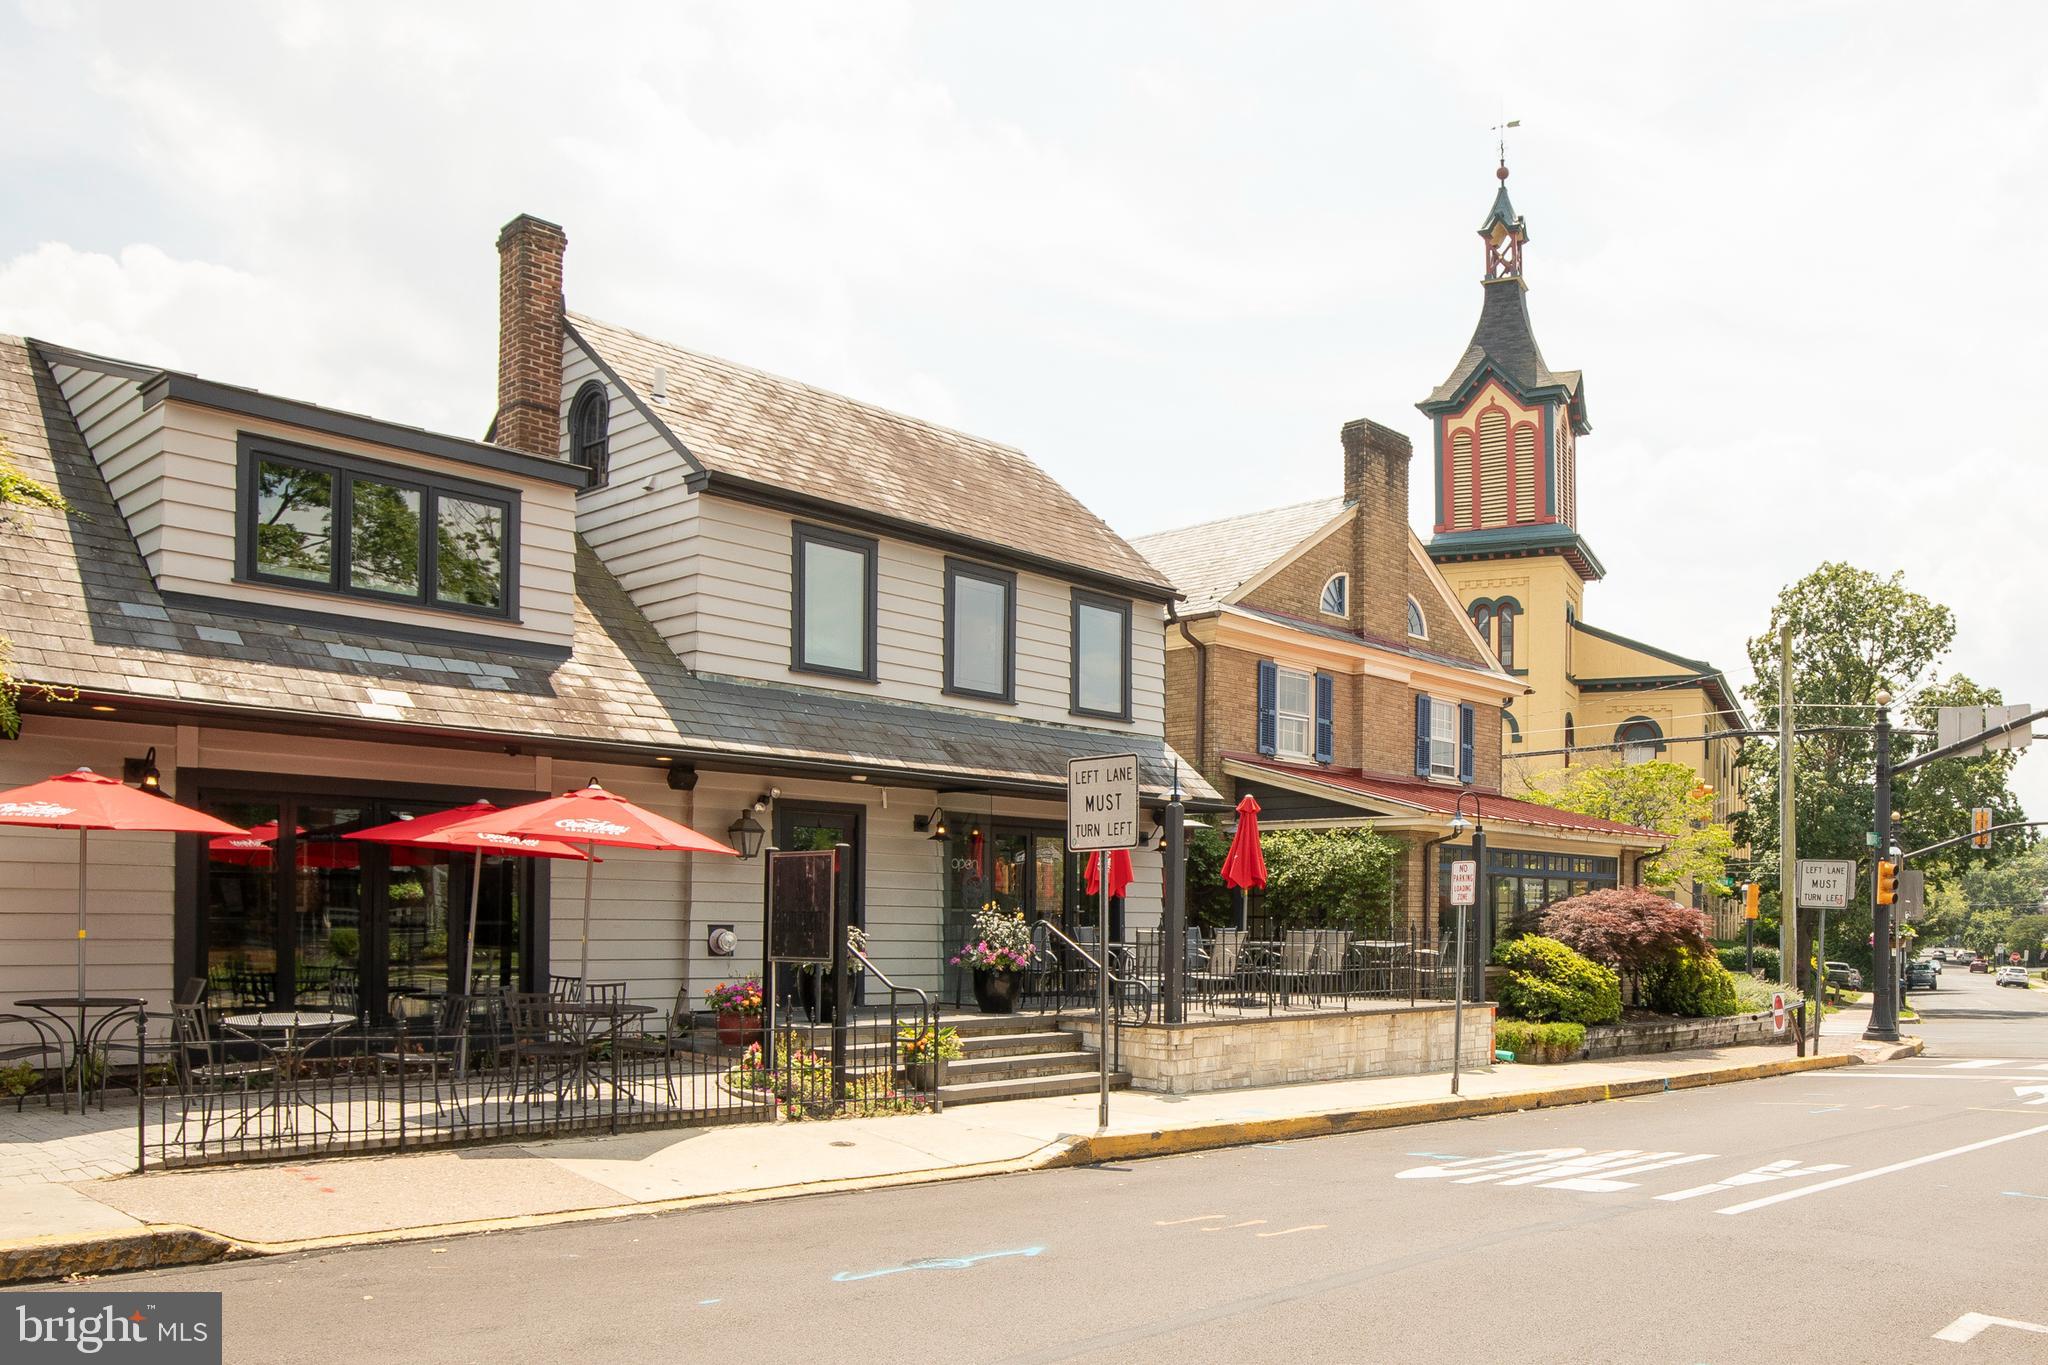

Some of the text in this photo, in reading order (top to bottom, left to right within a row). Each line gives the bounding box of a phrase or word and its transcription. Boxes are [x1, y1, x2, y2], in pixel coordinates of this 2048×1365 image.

[1075, 766, 1133, 785] LEFT LANE
[1085, 792, 1122, 813] MUST
[1075, 821, 1132, 838] TURN LEFT
[951, 857, 979, 872] open
[1459, 864, 1468, 873] NO
[1805, 866, 1846, 875] LEFT LANE
[1453, 874, 1473, 882] PARKING
[1811, 879, 1837, 889] MUST
[1804, 893, 1844, 902] TURN LEFT
